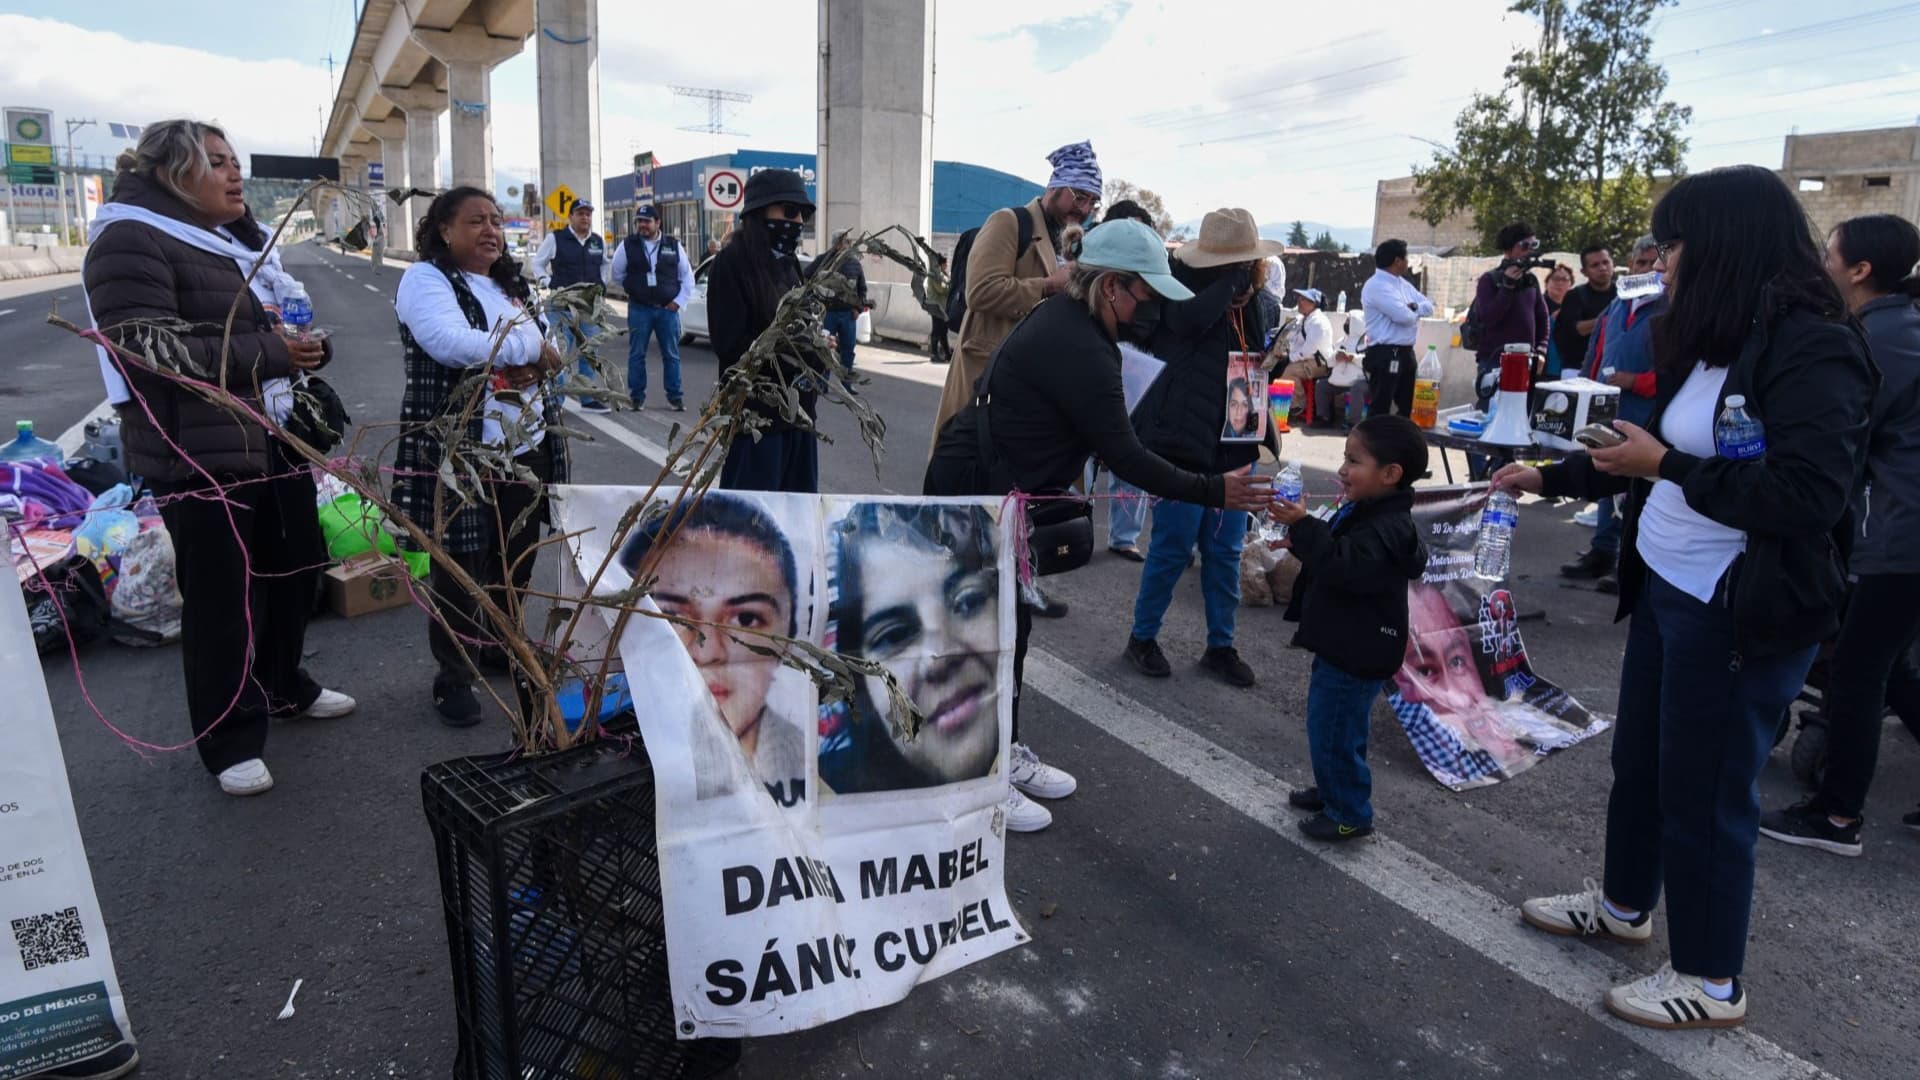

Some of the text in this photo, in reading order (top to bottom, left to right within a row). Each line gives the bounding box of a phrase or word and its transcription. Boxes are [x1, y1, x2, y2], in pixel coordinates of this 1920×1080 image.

[1432, 522, 1442, 534] 30
[0, 801, 19, 814] OS
[7, 862, 20, 872] DE
[23, 857, 44, 868] DOS
[859, 837, 989, 900] MABEL
[16, 869, 30, 879] EN
[31, 866, 45, 876] LA
[0, 993, 98, 1024] DO DE MÉXICO
[32, 1026, 47, 1036] de
[50, 1018, 84, 1032] delitos
[86, 1014, 100, 1023] en
[20, 1038, 38, 1049] por
[41, 1052, 56, 1061] La
